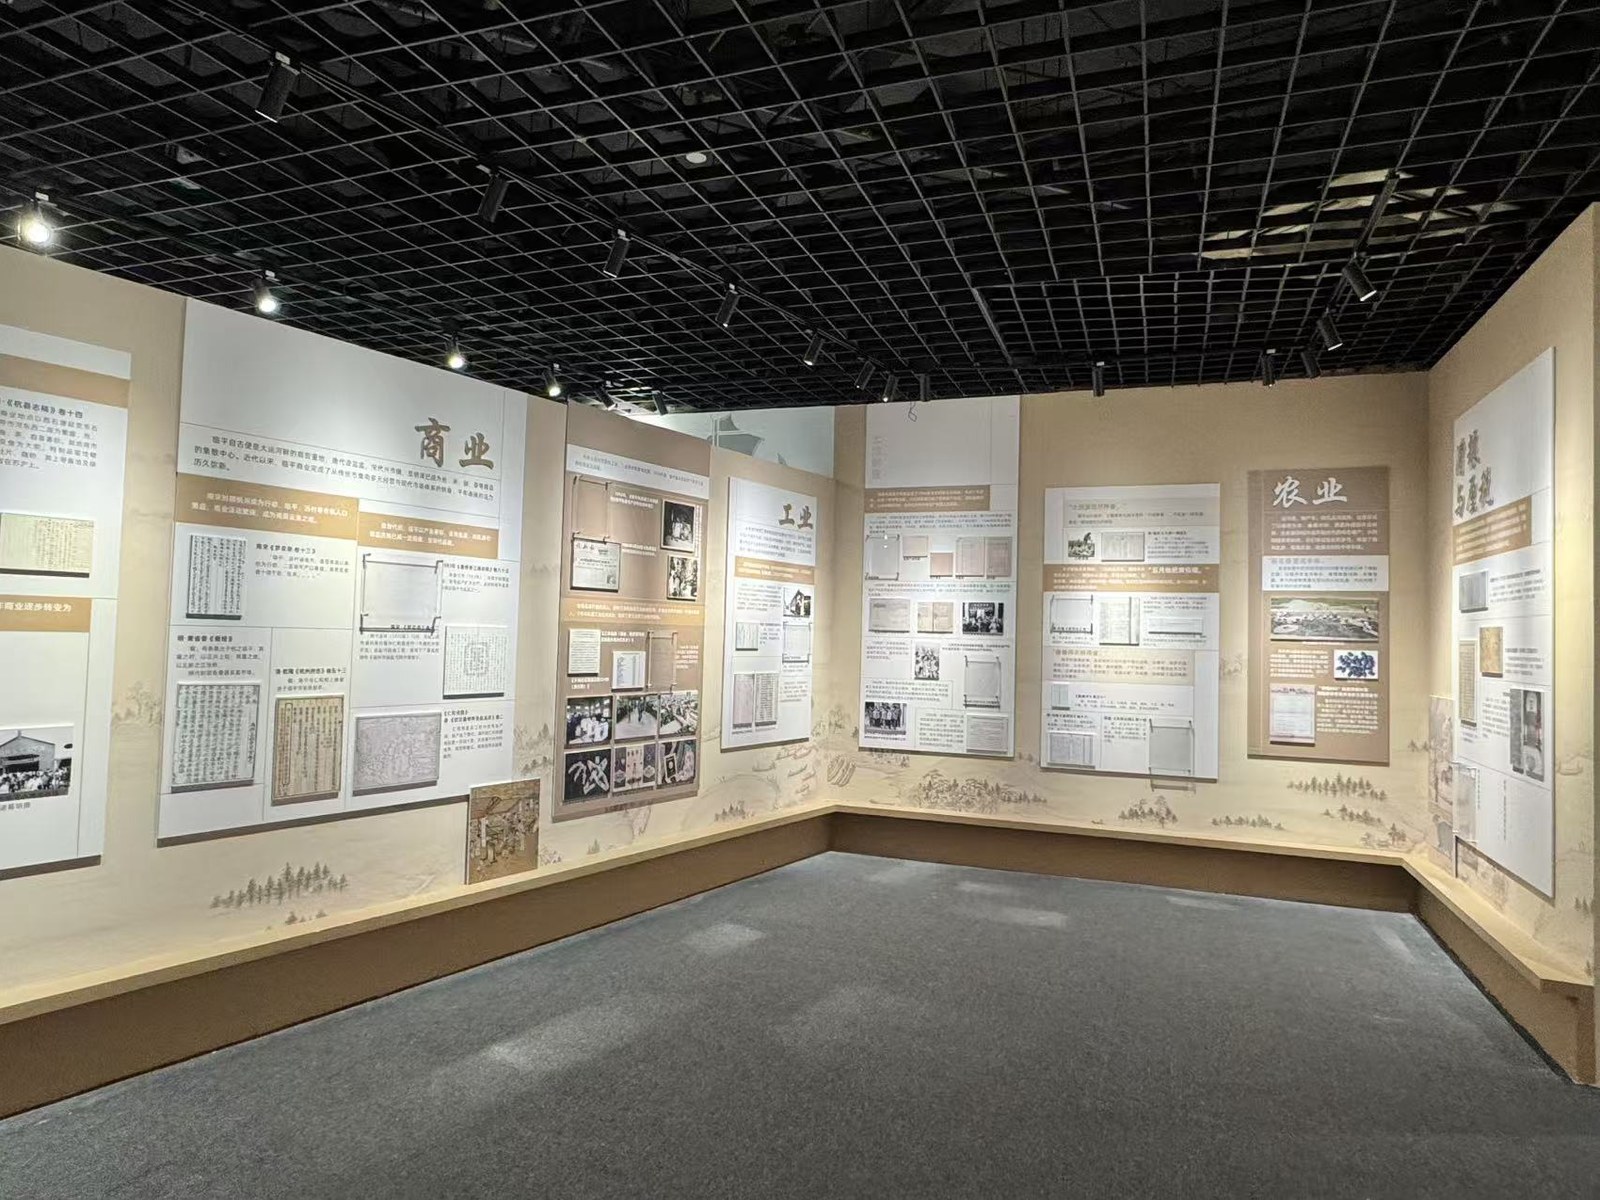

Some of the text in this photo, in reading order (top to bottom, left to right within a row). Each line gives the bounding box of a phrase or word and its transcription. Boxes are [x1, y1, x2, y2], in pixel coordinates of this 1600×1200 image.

[414, 417, 496, 471] 商业
[193, 457, 231, 471] 历久弥新。
[1272, 476, 1348, 508] 农业
[778, 503, 814, 530] 工业
